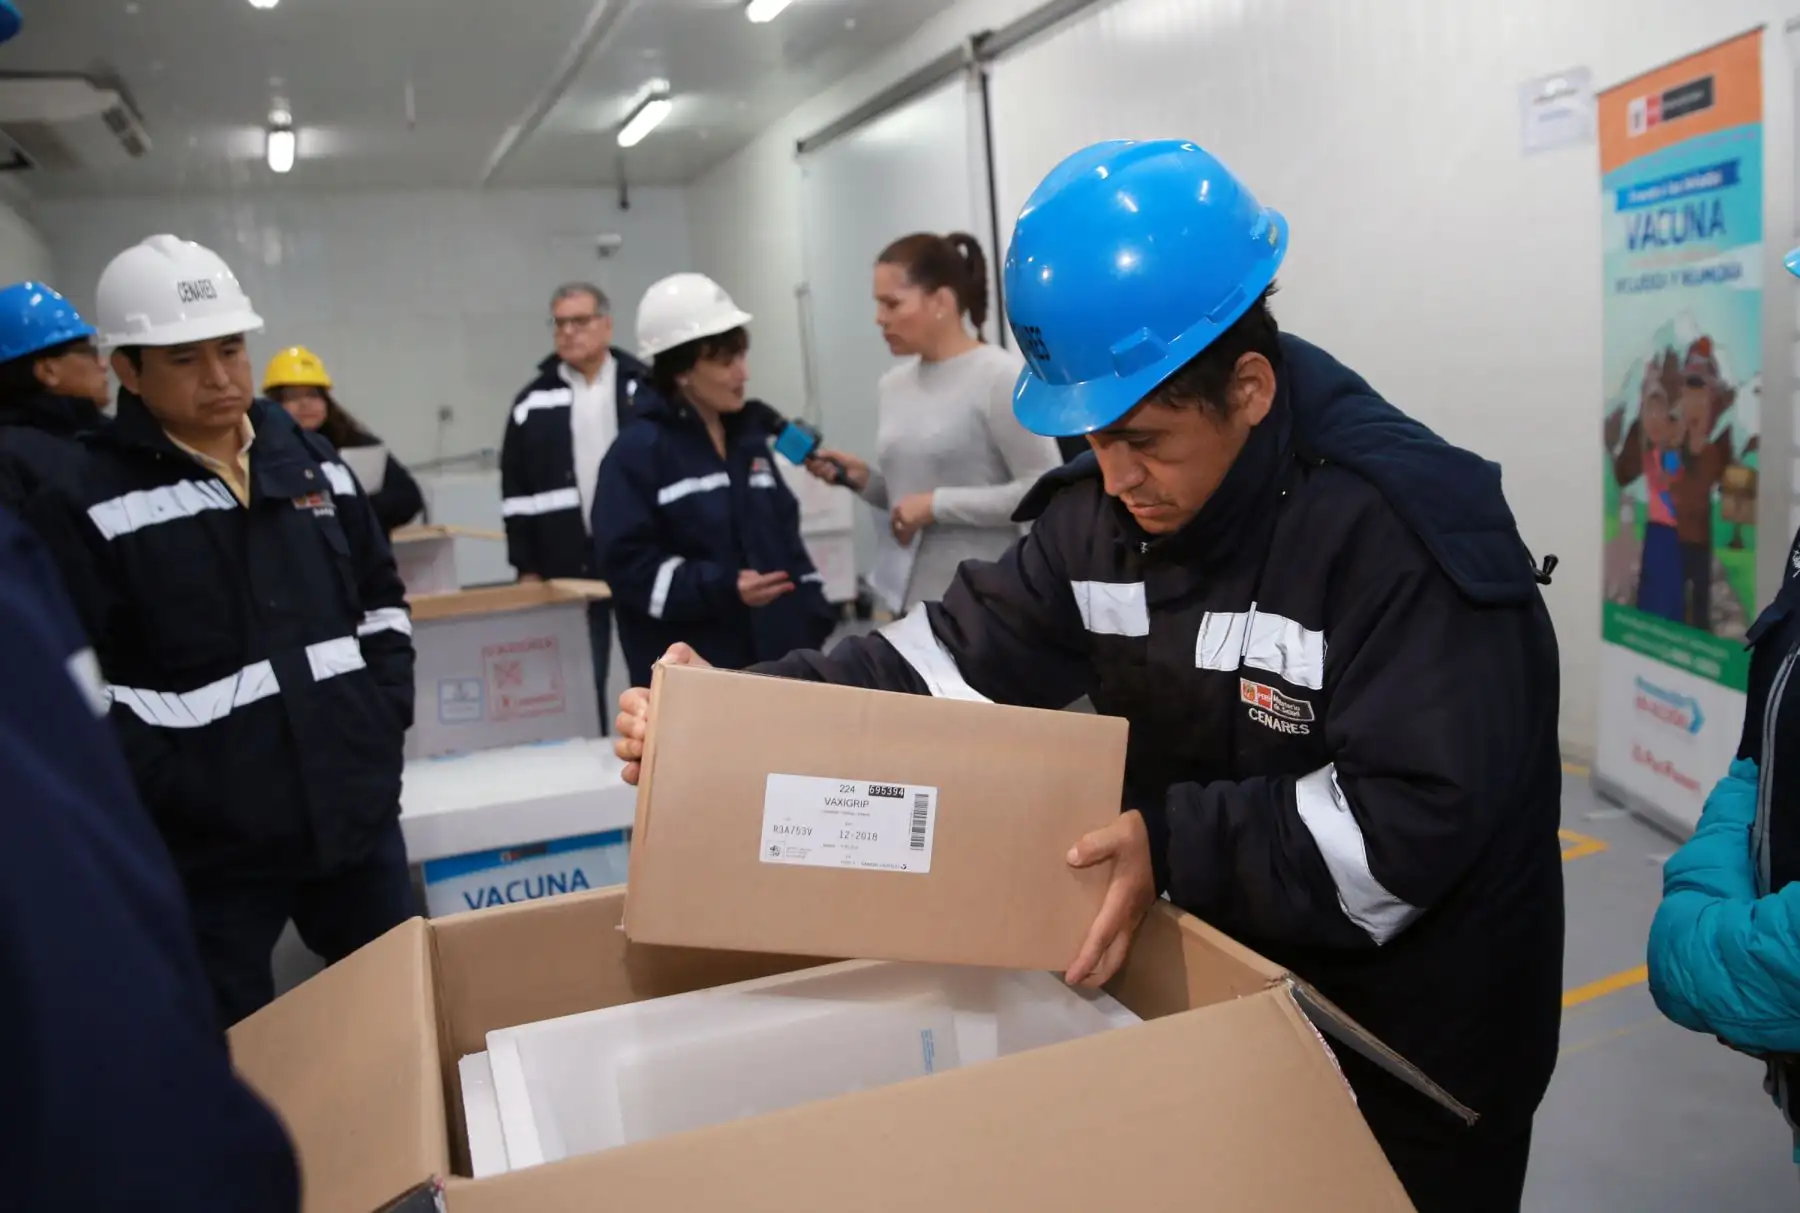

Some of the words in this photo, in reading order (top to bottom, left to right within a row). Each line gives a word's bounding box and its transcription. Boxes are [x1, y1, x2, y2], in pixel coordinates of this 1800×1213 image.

[1625, 197, 1727, 251] VACUNA
[177, 279, 218, 304] CENARES
[1248, 707, 1311, 735] CENARES
[839, 784, 855, 794] 224
[824, 797, 870, 808] VAXIGRIP
[839, 829, 878, 842] 12-2018
[462, 867, 590, 911] VACUNA
